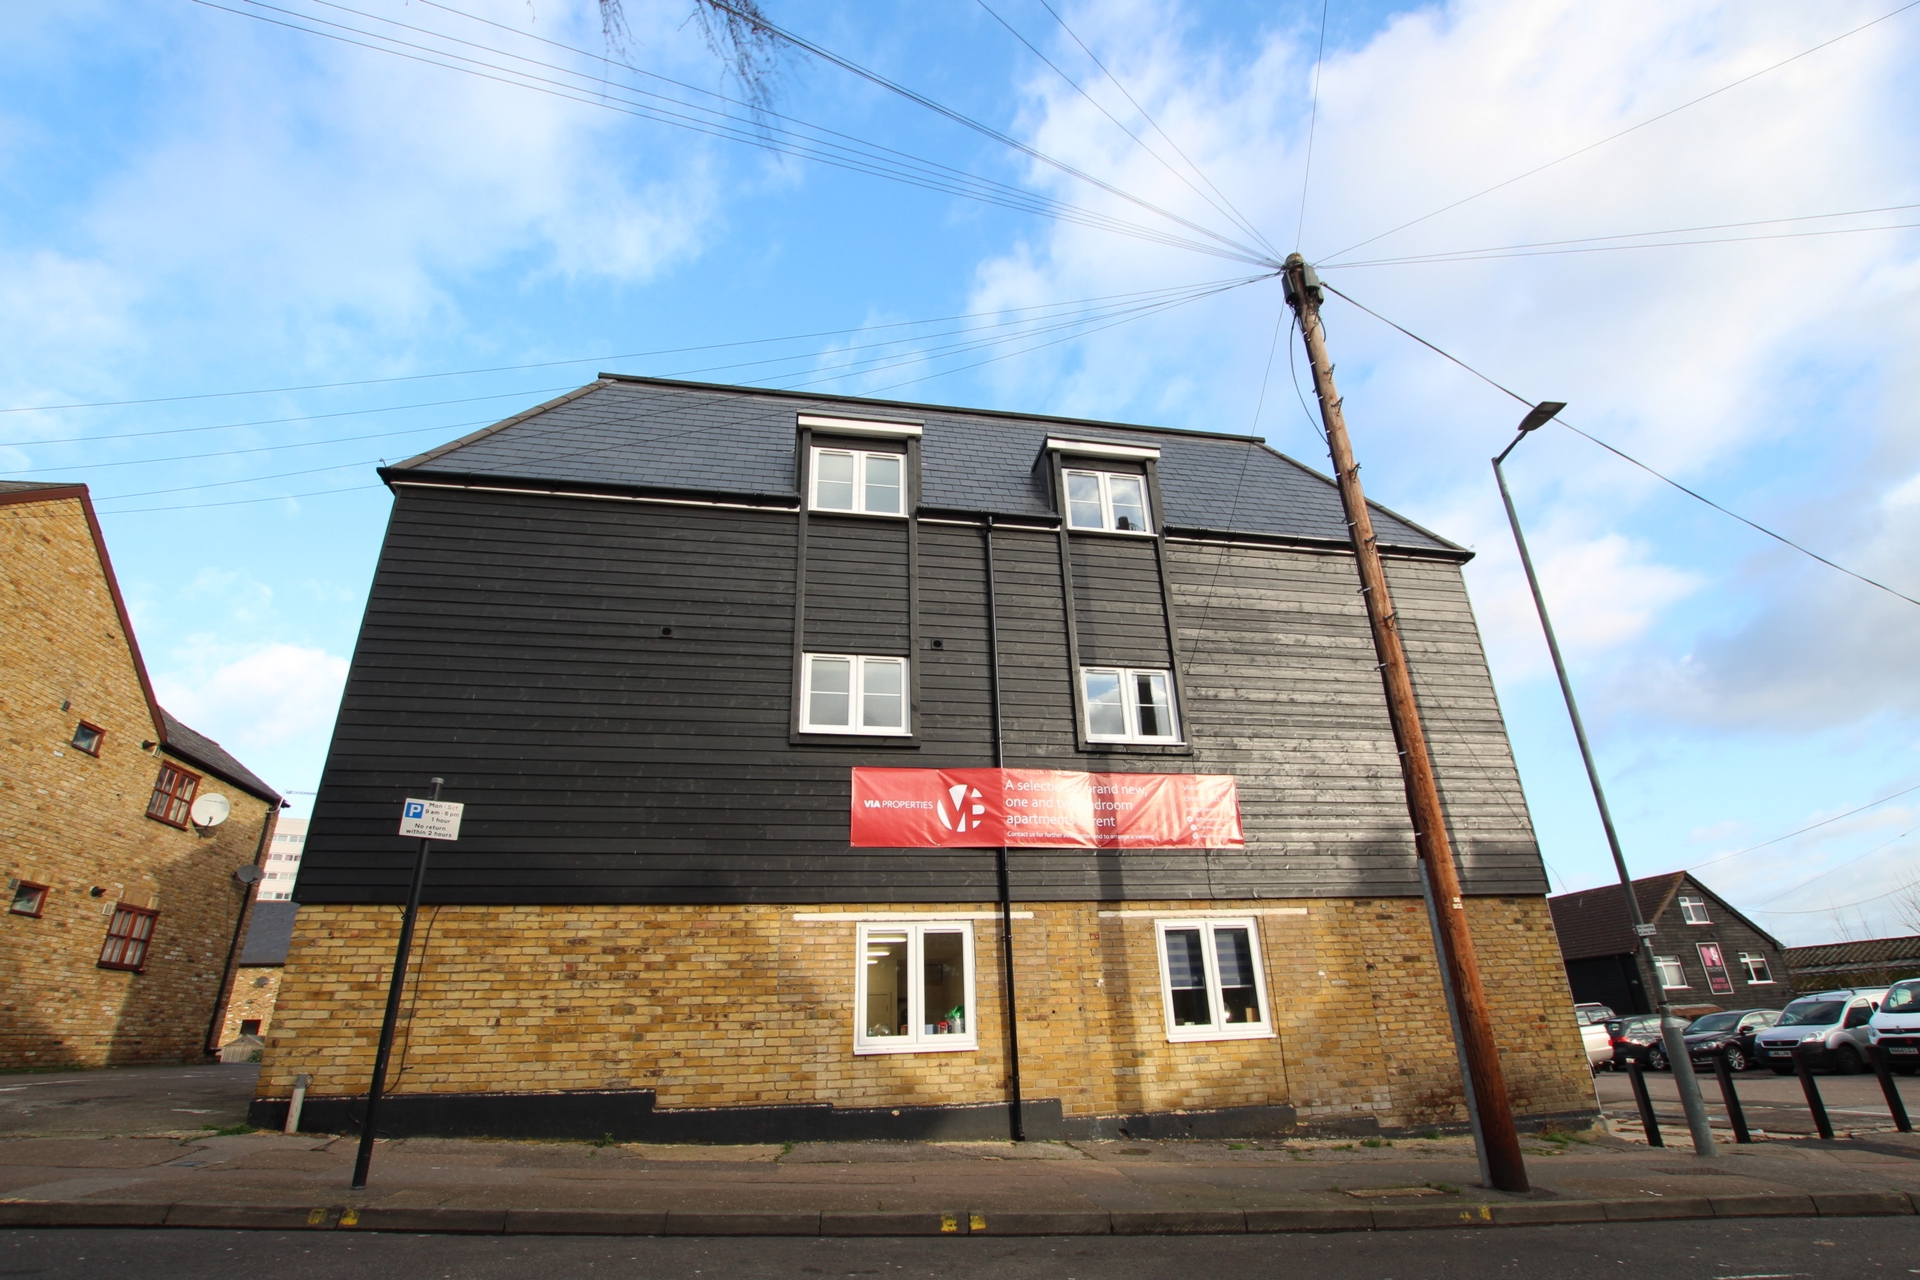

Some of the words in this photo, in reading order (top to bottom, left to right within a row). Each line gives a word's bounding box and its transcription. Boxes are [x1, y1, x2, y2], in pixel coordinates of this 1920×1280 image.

[1004, 780, 1014, 790] A
[1018, 780, 1069, 793] selection
[1121, 786, 1148, 797] new,
[864, 800, 881, 808] VIA
[882, 800, 934, 809] PROPERTIES
[1005, 798, 1028, 808] one
[1032, 797, 1053, 808] and
[408, 804, 421, 816] P
[1006, 815, 1075, 827] apartments
[1092, 817, 1116, 827] rent
[1135, 833, 1155, 841] viewing
